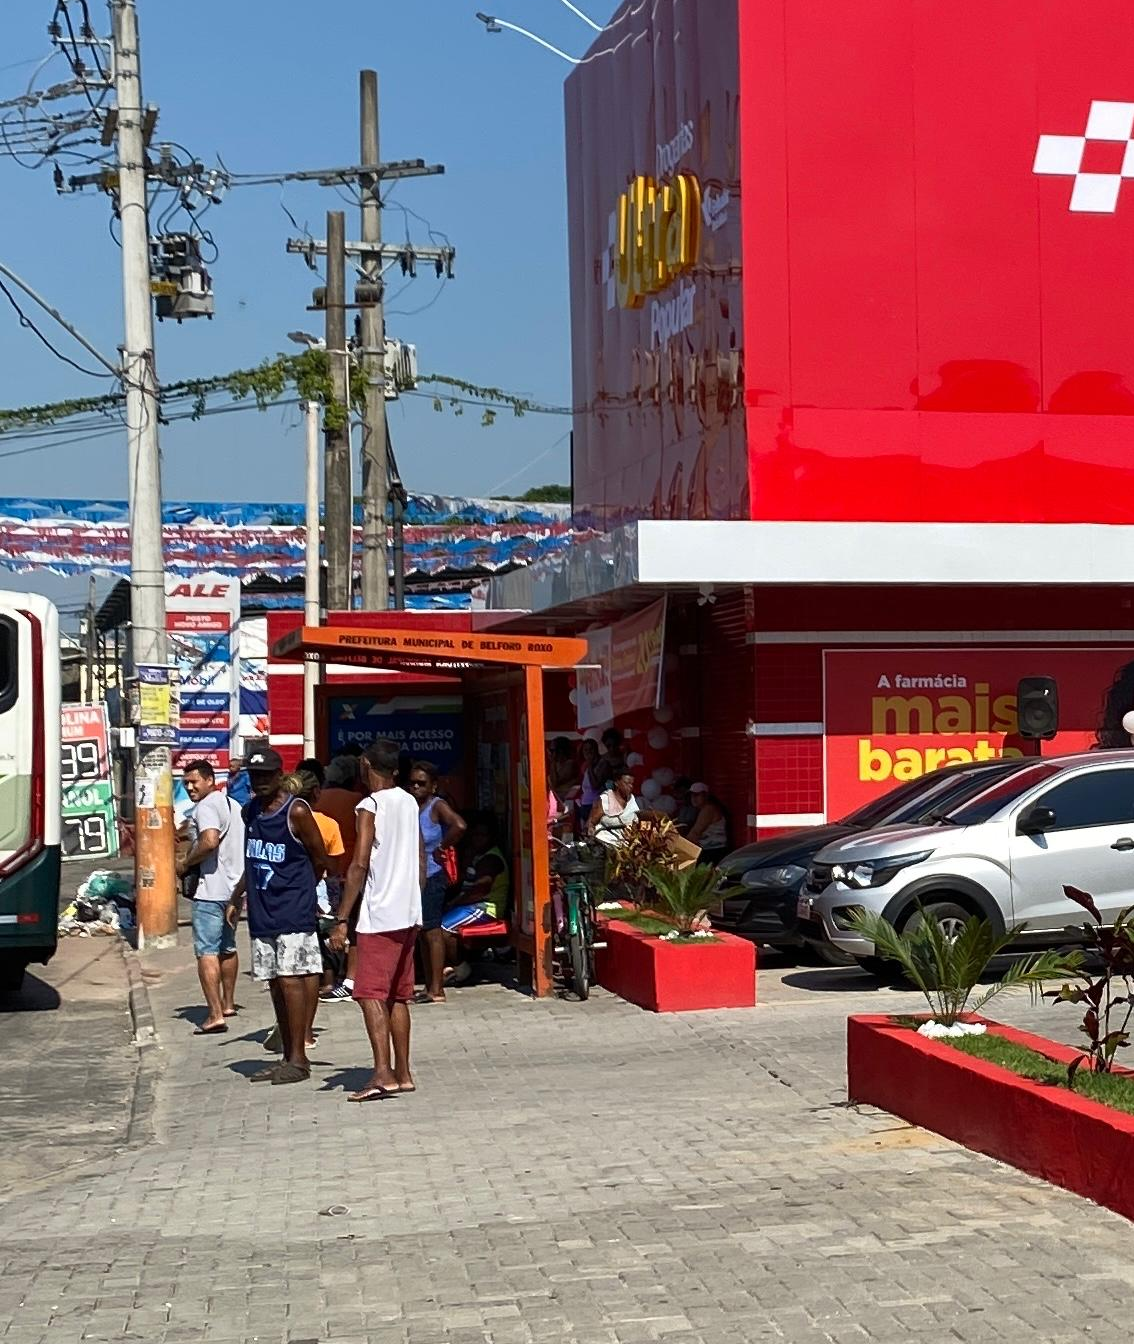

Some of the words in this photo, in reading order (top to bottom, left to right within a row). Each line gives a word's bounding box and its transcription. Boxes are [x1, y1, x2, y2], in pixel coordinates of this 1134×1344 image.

[169, 583, 230, 598] ALE
[338, 634, 397, 646] PREFEITURA
[403, 637, 454, 649] MUNICIPAL
[461, 640, 474, 650] DE
[480, 641, 522, 651] BELFORD
[527, 643, 553, 652] ROXO
[877, 675, 891, 688] A
[896, 674, 967, 688] farmácia
[872, 683, 1018, 736] mais
[348, 731, 373, 741] POR
[409, 729, 454, 740] ACESSO
[413, 740, 452, 752] DIGNA
